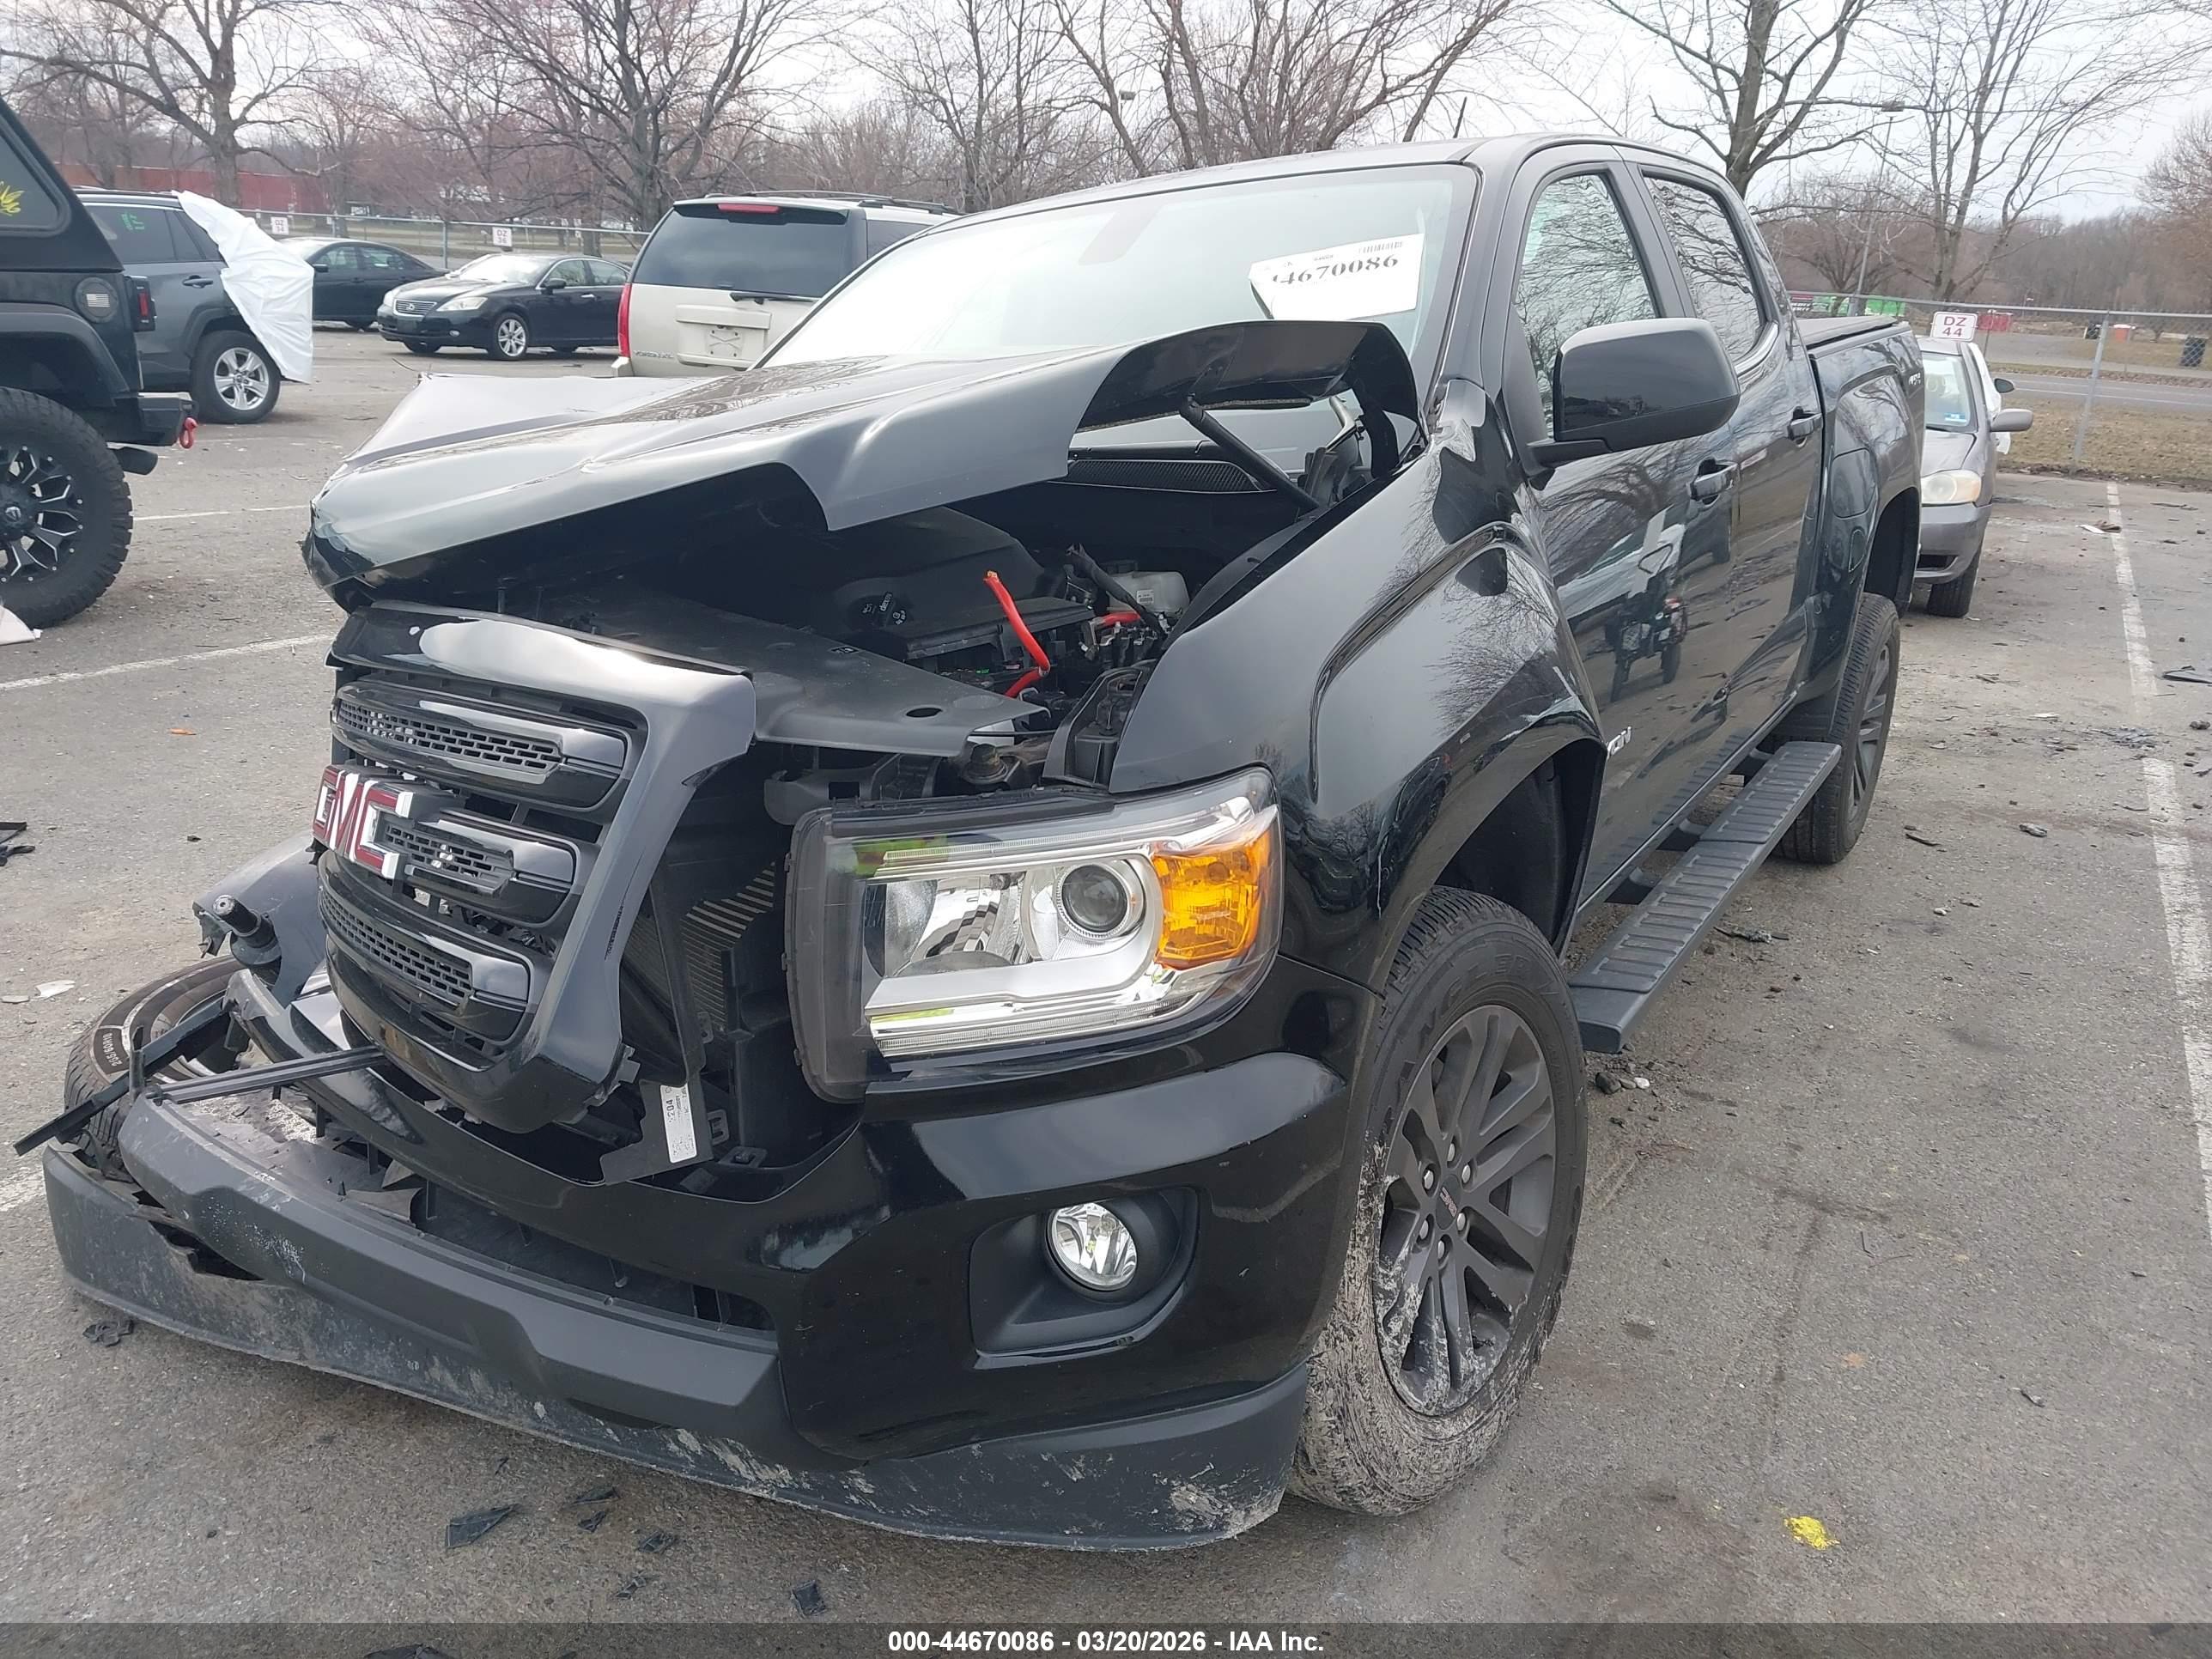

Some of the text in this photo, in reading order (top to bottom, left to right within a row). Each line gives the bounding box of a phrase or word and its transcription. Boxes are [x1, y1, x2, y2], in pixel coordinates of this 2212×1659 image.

[1943, 315, 1967, 327] DZ
[1942, 326, 1963, 337] 44
[312, 764, 414, 880] GMC
